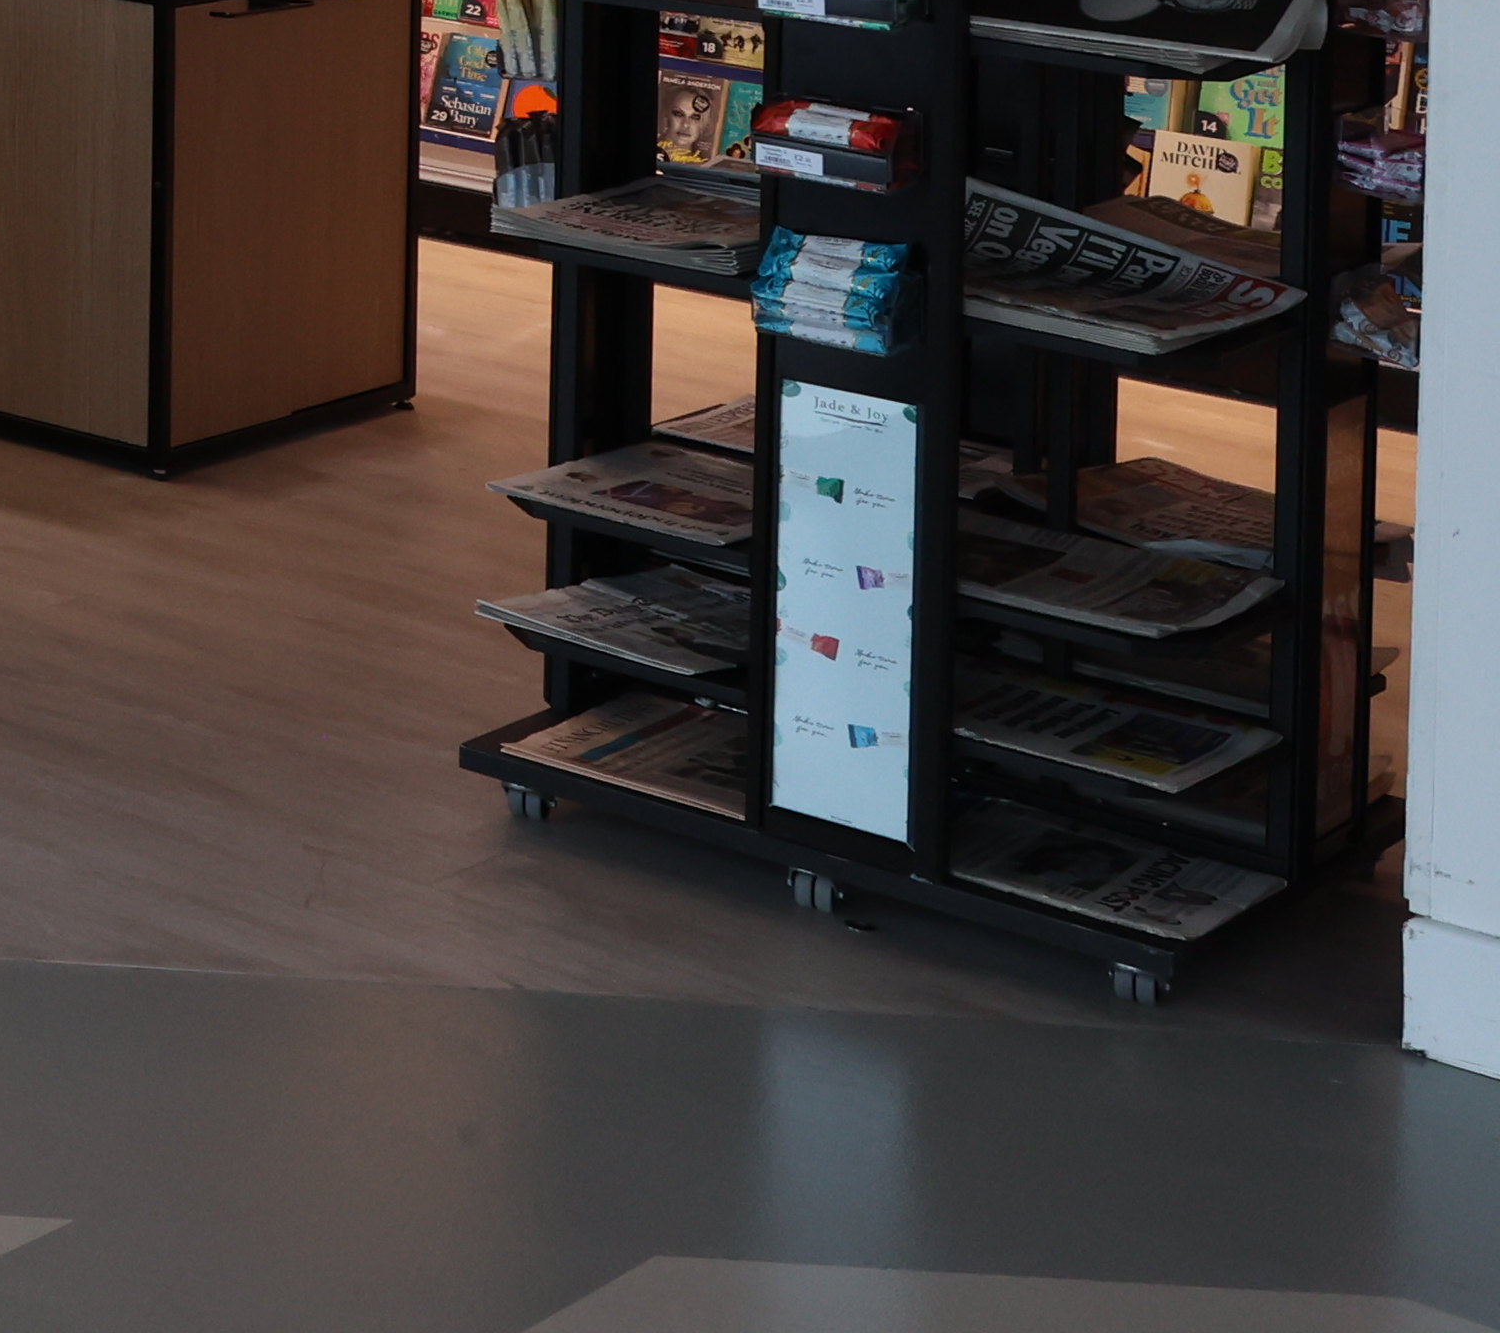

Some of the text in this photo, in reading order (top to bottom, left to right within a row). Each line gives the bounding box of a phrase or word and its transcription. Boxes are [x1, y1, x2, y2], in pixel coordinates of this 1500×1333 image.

[465, 4, 482, 16] 22
[686, 79, 721, 92] ANDERSON
[440, 95, 492, 116] Sebastian
[431, 110, 448, 122] 29
[814, 396, 889, 423] Jade & Joy
